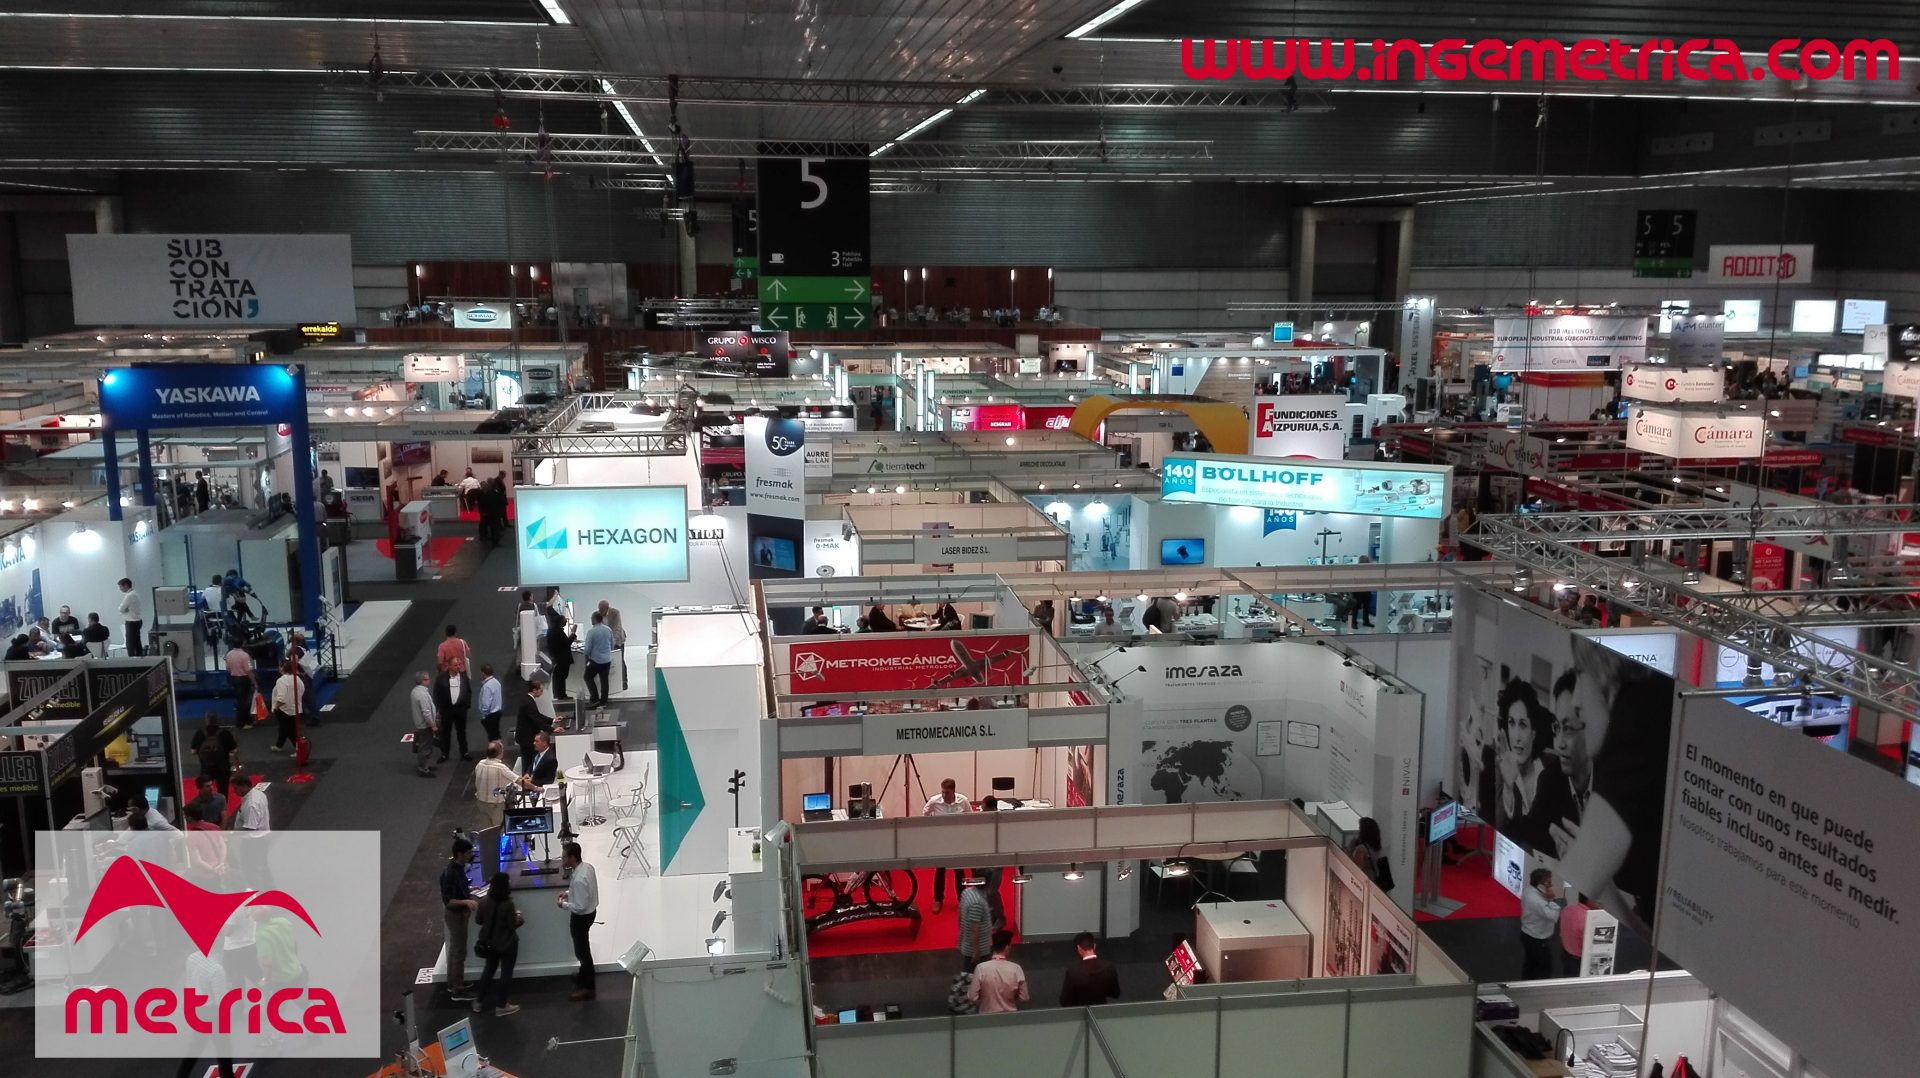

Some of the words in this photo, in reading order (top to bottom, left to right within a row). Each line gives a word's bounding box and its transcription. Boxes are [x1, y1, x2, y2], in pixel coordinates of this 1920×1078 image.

[800, 157, 828, 209] 5
[1672, 215, 1684, 235] 5
[167, 239, 223, 258] SUB
[831, 251, 840, 267] 3
[169, 259, 230, 278] CON
[170, 280, 257, 298] TRATA
[707, 337, 736, 345] GRUPO
[750, 337, 777, 345] WISCO
[156, 385, 261, 404] YASKAWA
[1265, 409, 1338, 421] FUNDICIONES
[1635, 419, 1673, 438] Cámara
[1694, 425, 1753, 444] Cámara
[771, 435, 788, 450] 50
[1165, 464, 1194, 477] 140
[756, 477, 793, 489] fresmak
[1165, 476, 1193, 485] AÑOS
[578, 528, 677, 545] HEXAGON
[942, 547, 960, 555] LASER
[962, 546, 979, 554] BIDEZ
[980, 546, 990, 554] S.L.
[826, 653, 957, 669] METROMECÁNICA
[1165, 665, 1243, 679] imesaza
[896, 725, 977, 740] METROMECANICA
[980, 725, 996, 737] S.L.
[0, 755, 37, 782] LLER
[1686, 743, 1697, 762] El
[1701, 753, 1764, 797] momento
[1769, 789, 1786, 808] en
[1791, 800, 1819, 825] que
[1824, 817, 1874, 854] puede
[1684, 768, 1725, 800] contar
[1728, 793, 1752, 816] con
[1757, 809, 1791, 836] unos
[1796, 829, 1877, 883] resultados
[1682, 789, 1722, 824] fiables
[1726, 813, 1774, 852] incluso
[1779, 846, 1819, 878] antes
[1824, 869, 1844, 892] de
[1848, 884, 1900, 925] medir.
[1680, 814, 1716, 844] Nosotros
[1717, 837, 1764, 873] trabajamos
[1766, 867, 1787, 887] para
[1789, 881, 1809, 900] este
[1811, 893, 1861, 930] momento
